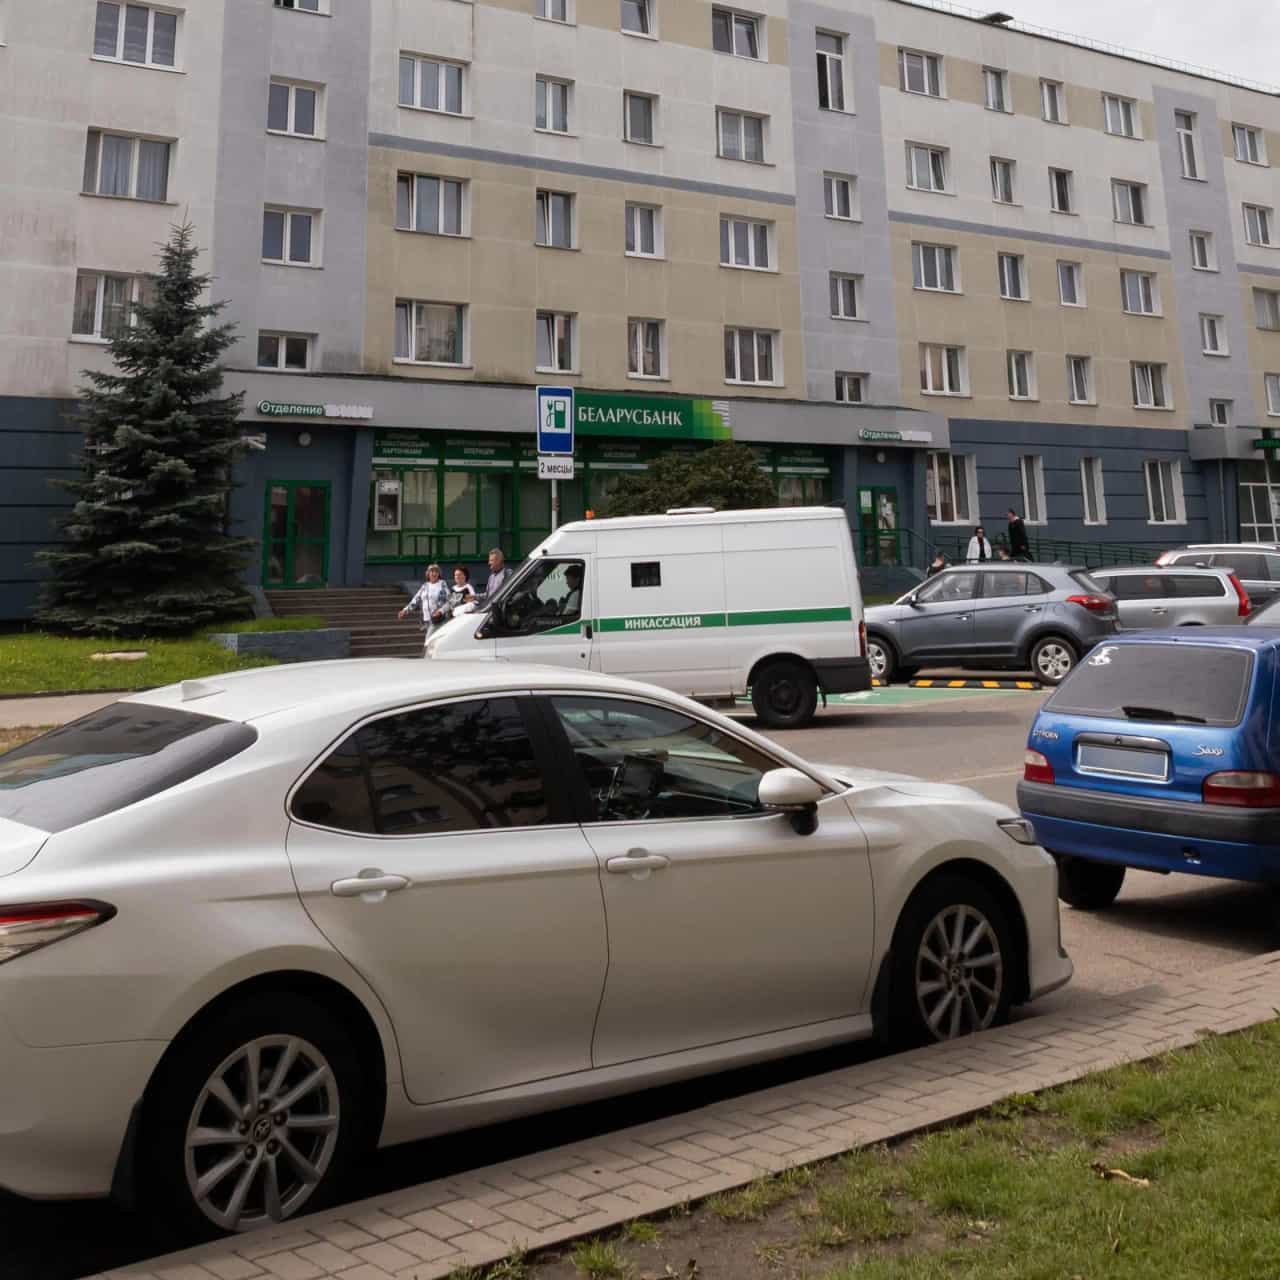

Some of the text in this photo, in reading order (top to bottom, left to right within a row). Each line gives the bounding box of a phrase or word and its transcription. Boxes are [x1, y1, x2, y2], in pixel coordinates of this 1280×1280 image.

[260, 400, 323, 416] Отделение
[578, 406, 683, 426] БЕЛАРУСБАНК
[540, 462, 545, 474] 2
[624, 616, 702, 629] ИНКАССАЦИЯ
